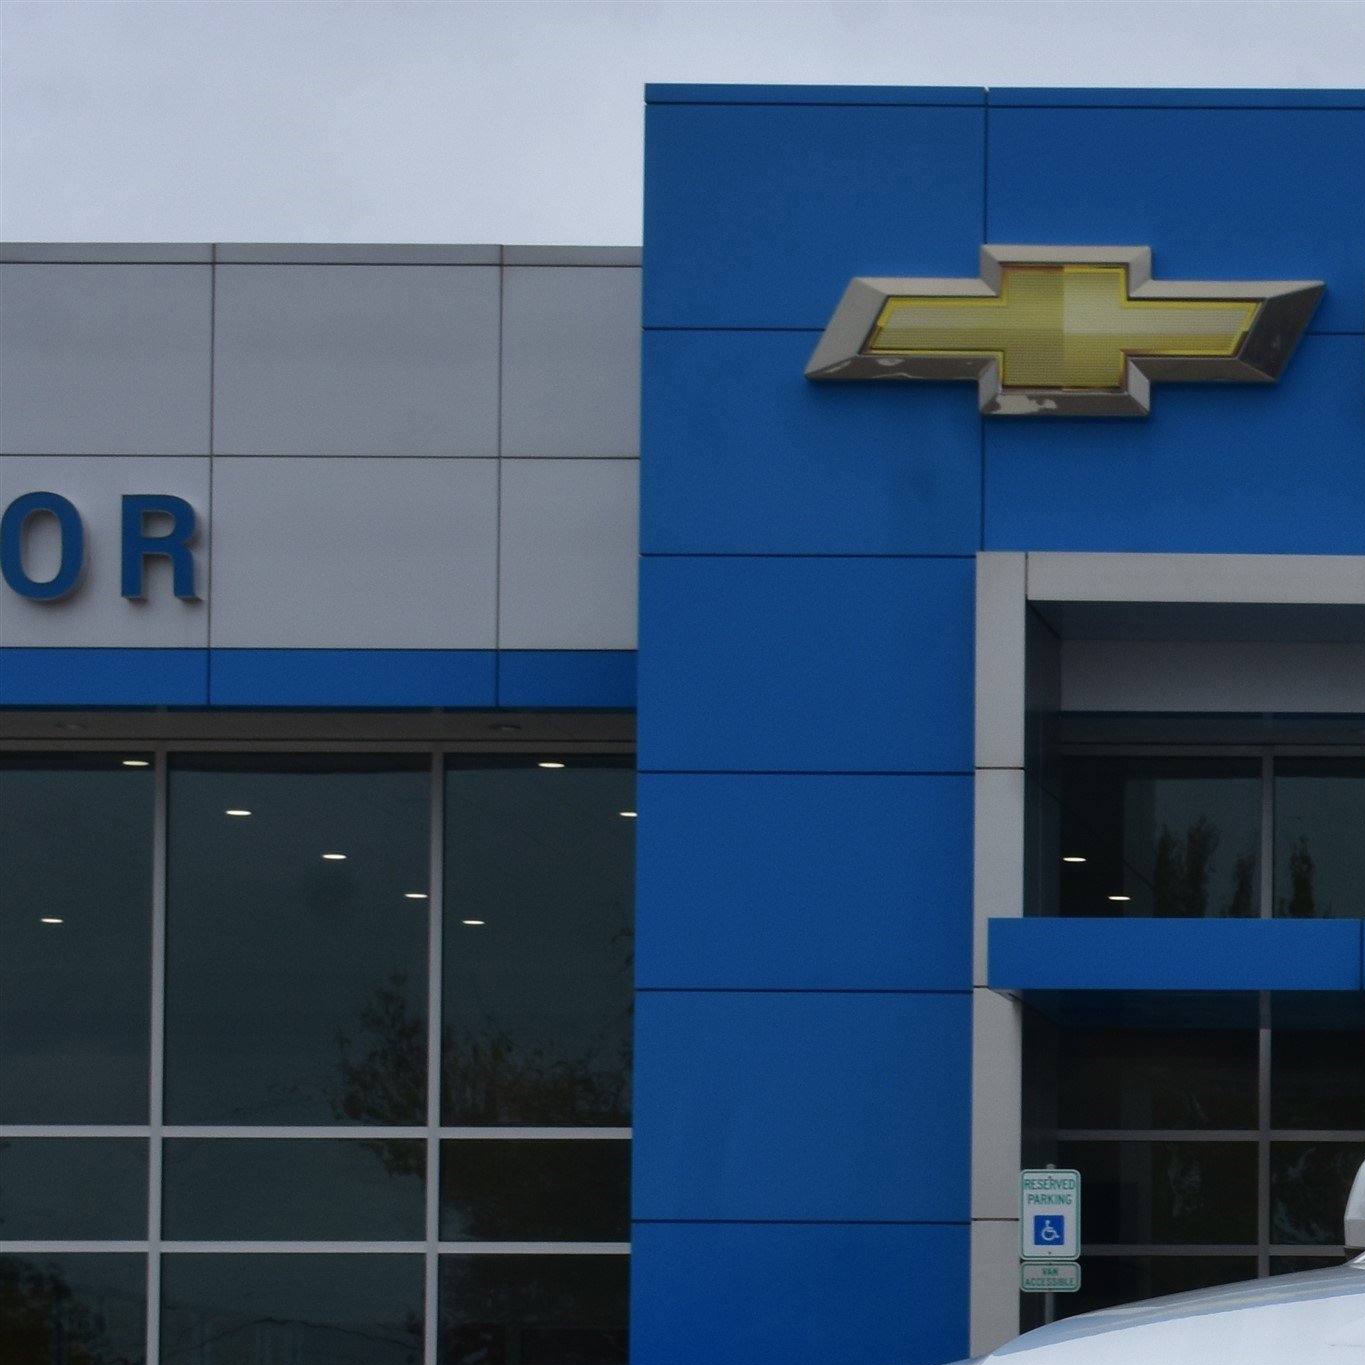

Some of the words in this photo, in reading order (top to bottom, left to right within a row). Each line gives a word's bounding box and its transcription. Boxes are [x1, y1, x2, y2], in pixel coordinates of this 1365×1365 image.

[1024, 1178, 1076, 1190] RESERVED
[1027, 1193, 1073, 1205] PARKING
[1042, 1268, 1059, 1276] VAN
[1024, 1278, 1075, 1287] ACCESSIBLE
